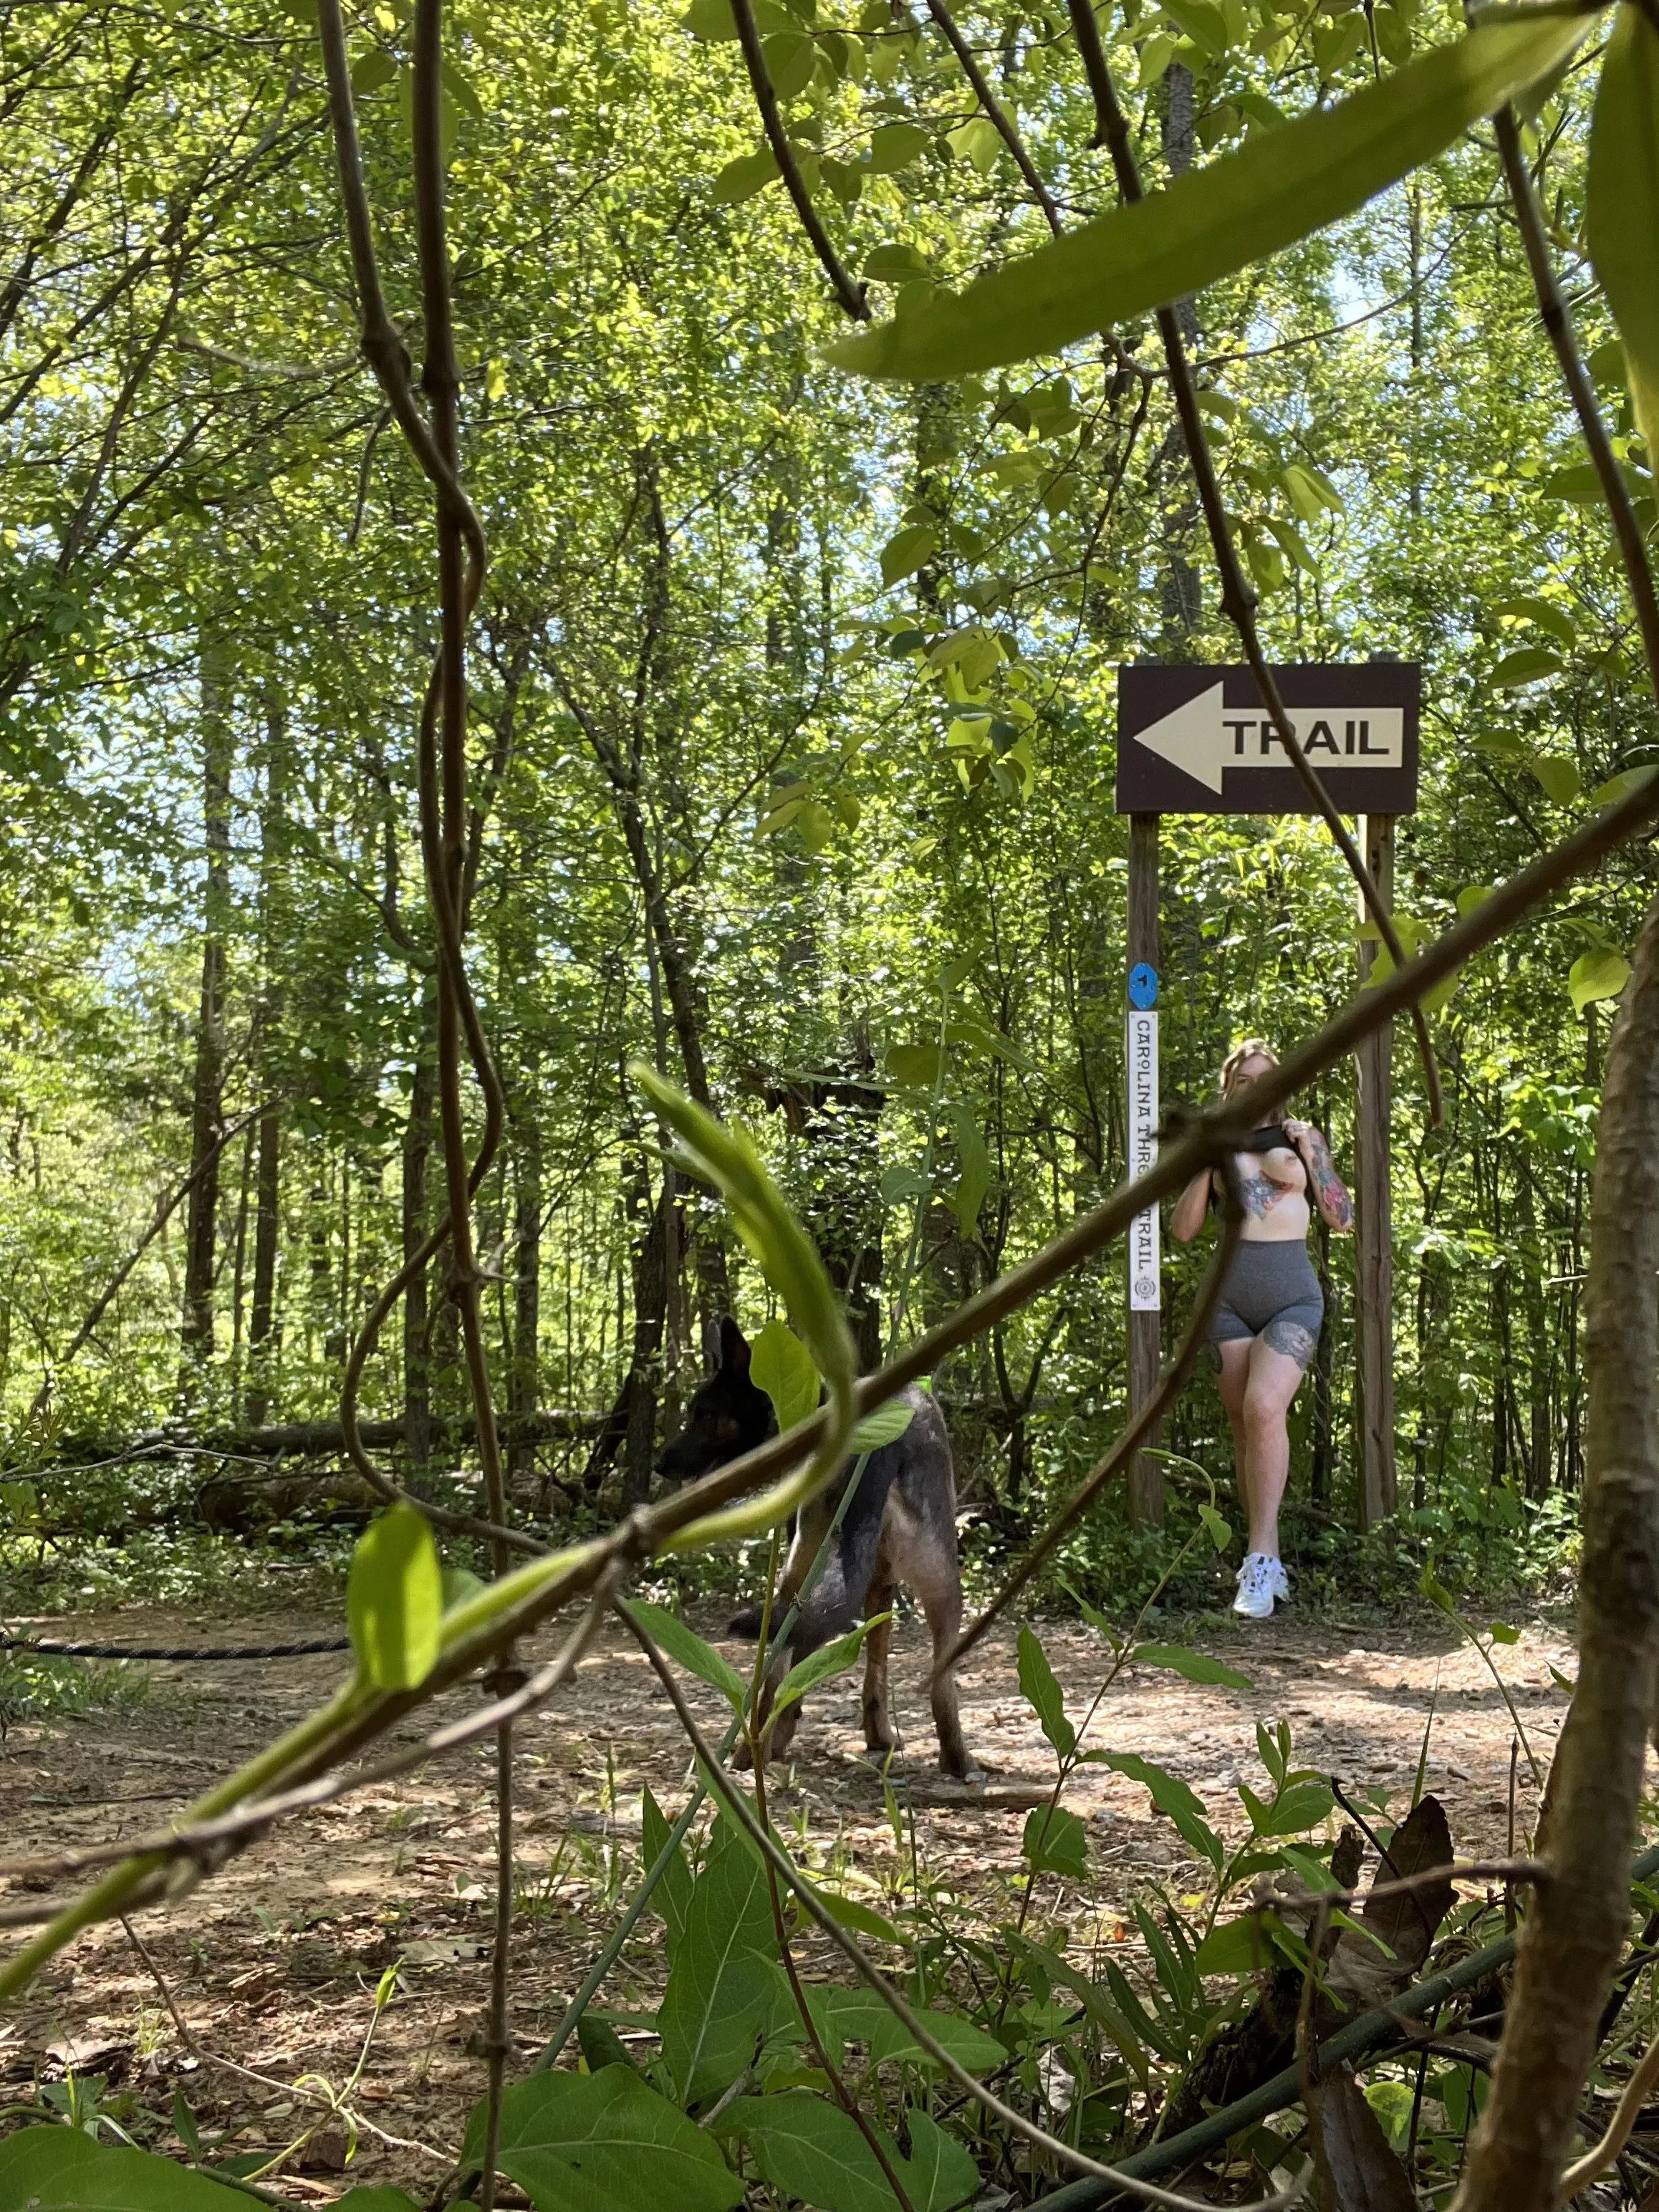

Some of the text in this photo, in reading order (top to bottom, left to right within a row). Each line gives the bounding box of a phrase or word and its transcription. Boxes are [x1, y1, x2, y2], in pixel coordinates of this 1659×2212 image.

[1222, 720, 1390, 755] TRAIL
[1137, 1019, 1152, 1269] CAROLINA THRE TRAIL
